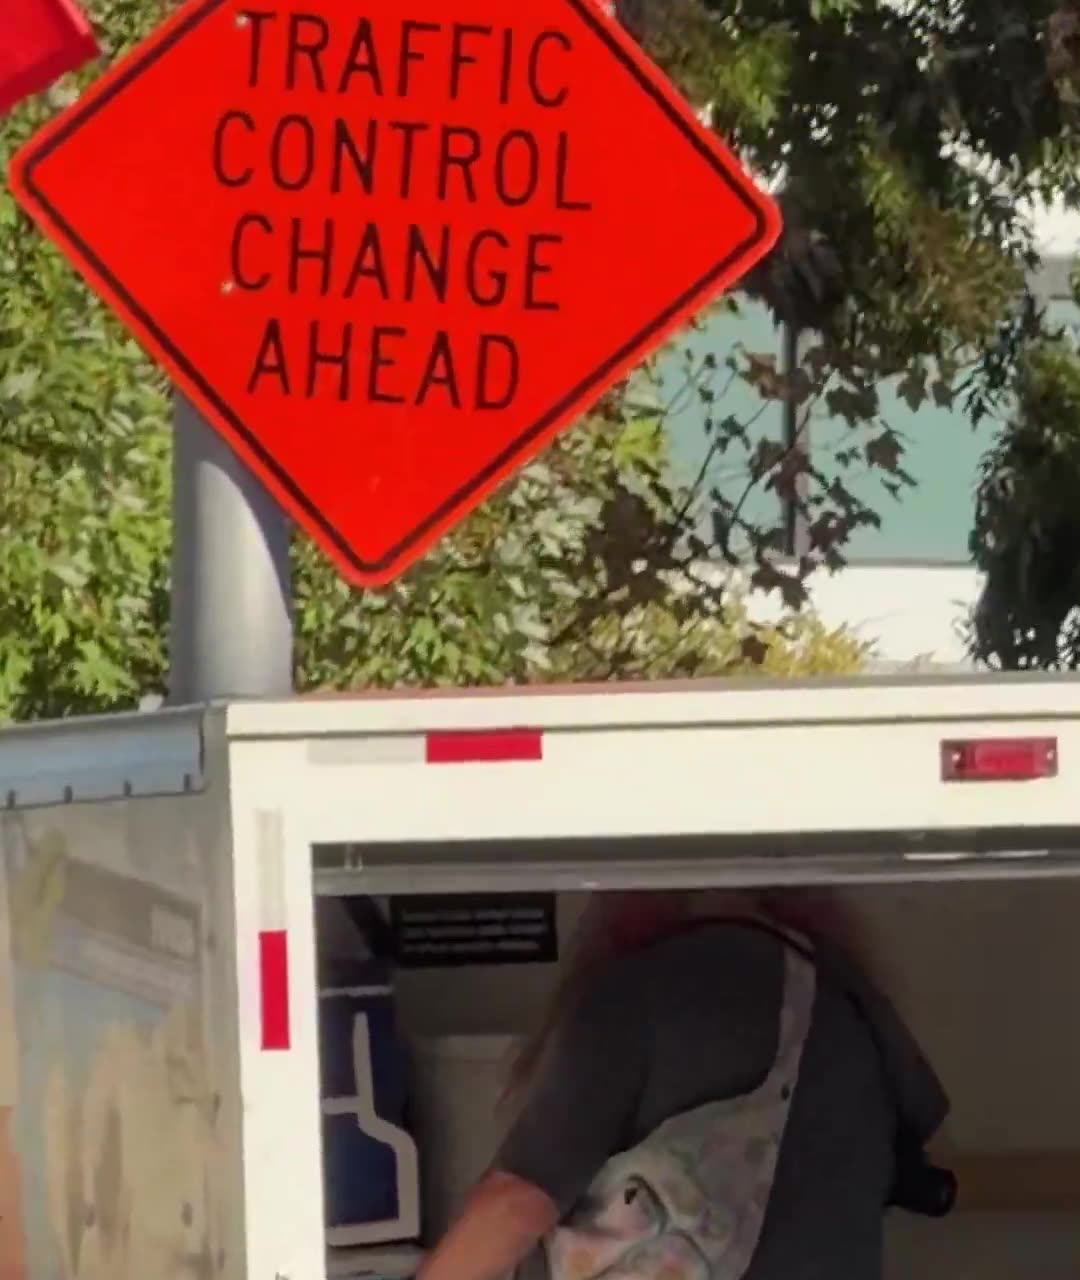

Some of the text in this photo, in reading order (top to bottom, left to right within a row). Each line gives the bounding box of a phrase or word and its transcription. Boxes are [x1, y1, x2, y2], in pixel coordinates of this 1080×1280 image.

[242, 10, 573, 107] TRAFFIC
[212, 110, 592, 211] CONTROL
[230, 213, 563, 311] CHANGE
[247, 319, 520, 411] AHEAD
